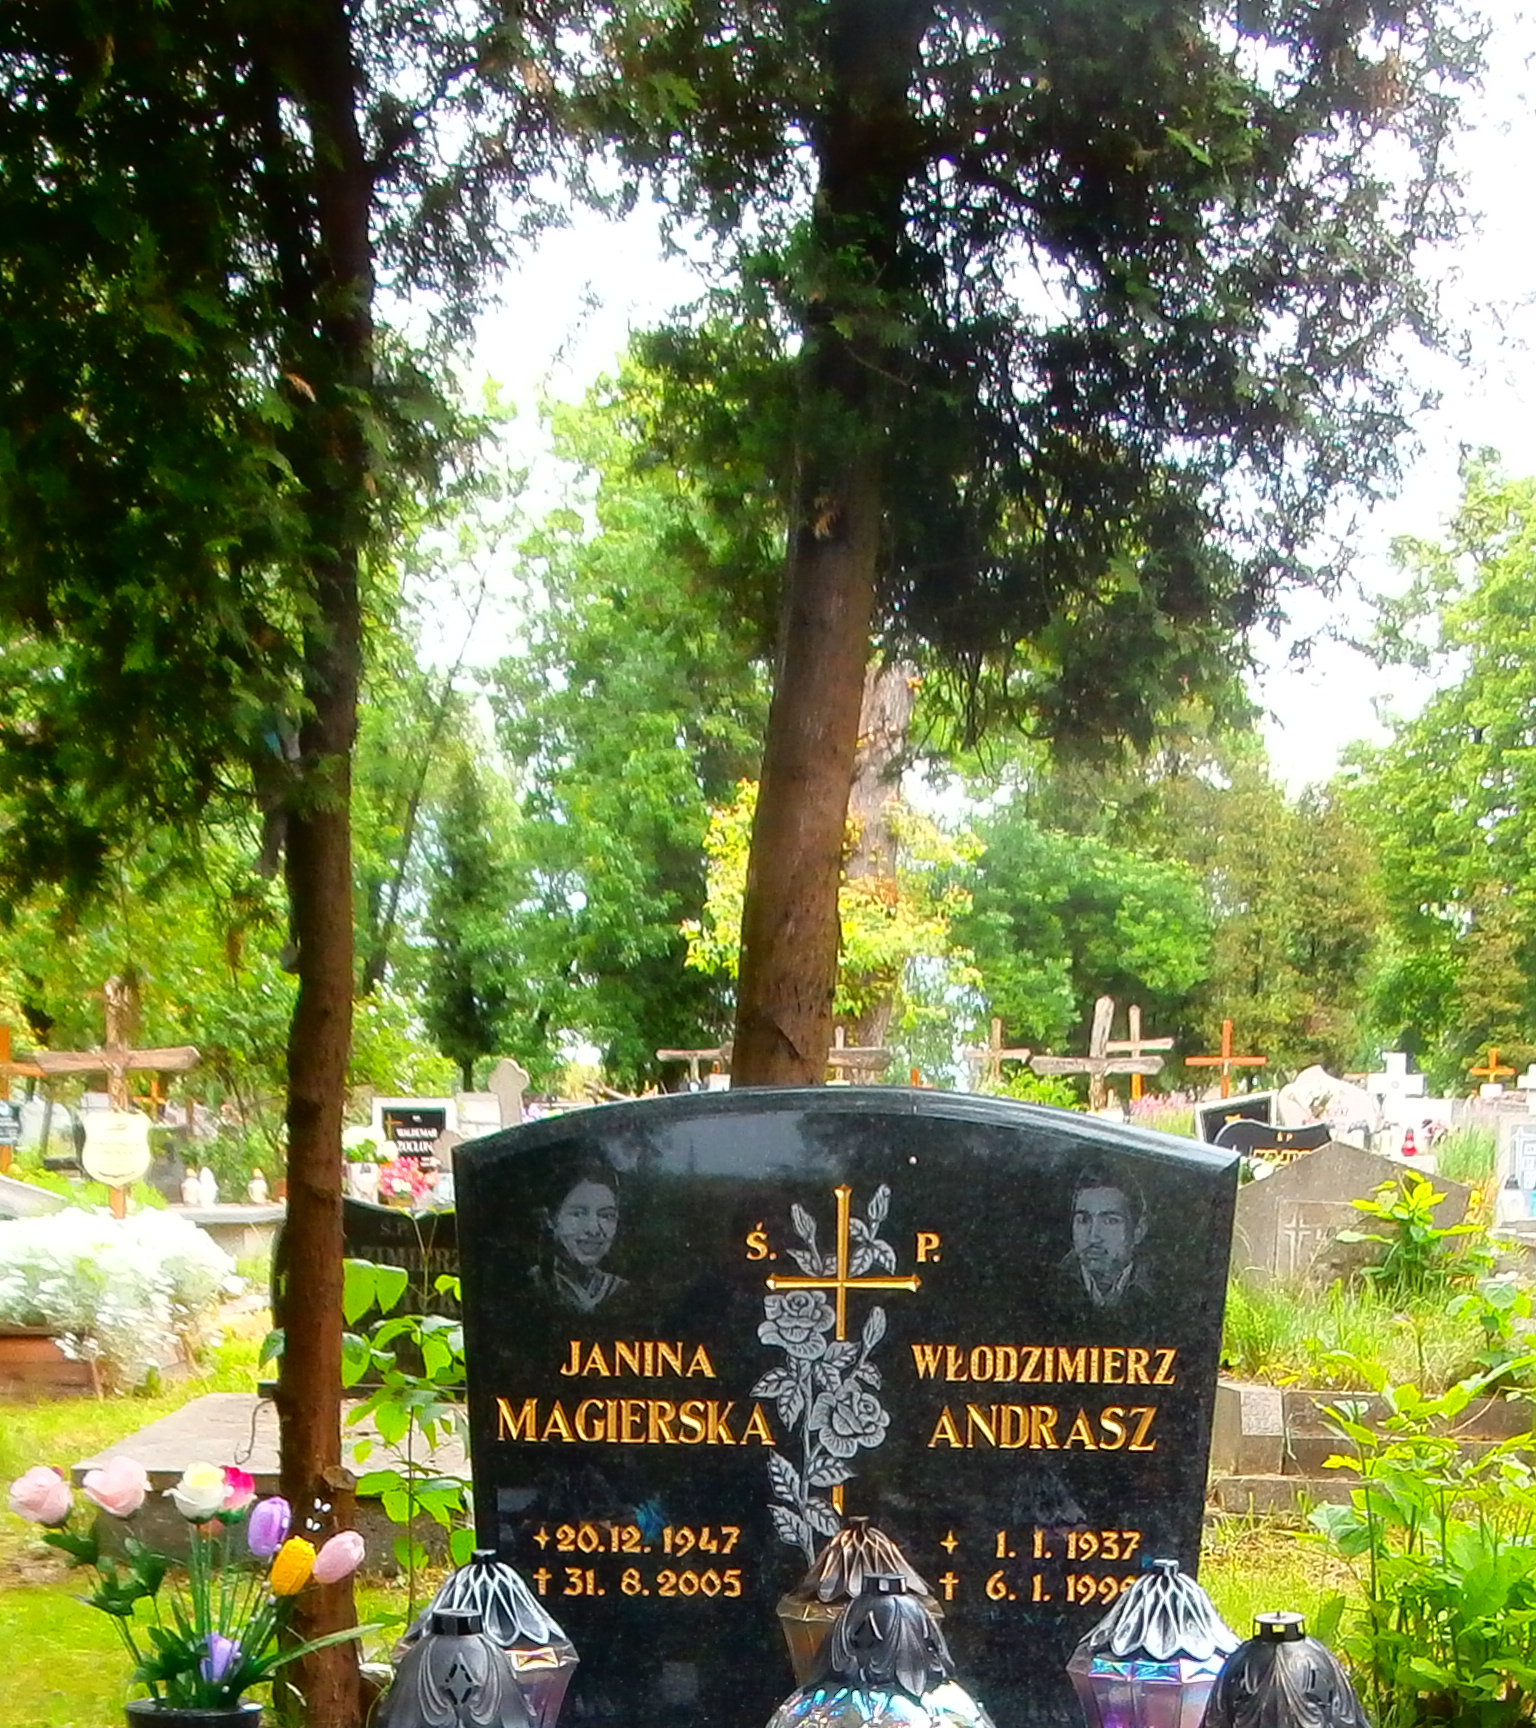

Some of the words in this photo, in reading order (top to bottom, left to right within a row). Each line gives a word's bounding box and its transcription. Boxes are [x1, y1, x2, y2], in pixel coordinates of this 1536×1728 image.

[745, 1222, 777, 1261] Ś.
[916, 1232, 942, 1263] P.
[560, 1340, 717, 1378] JANINA
[911, 1344, 1177, 1385] WŁODZIMIERZ
[495, 1396, 776, 1446] MAGIERSKA
[927, 1403, 1158, 1452] ANDRASZ
[663, 1524, 741, 1558] 1947
[1066, 1529, 1142, 1561] 1937
